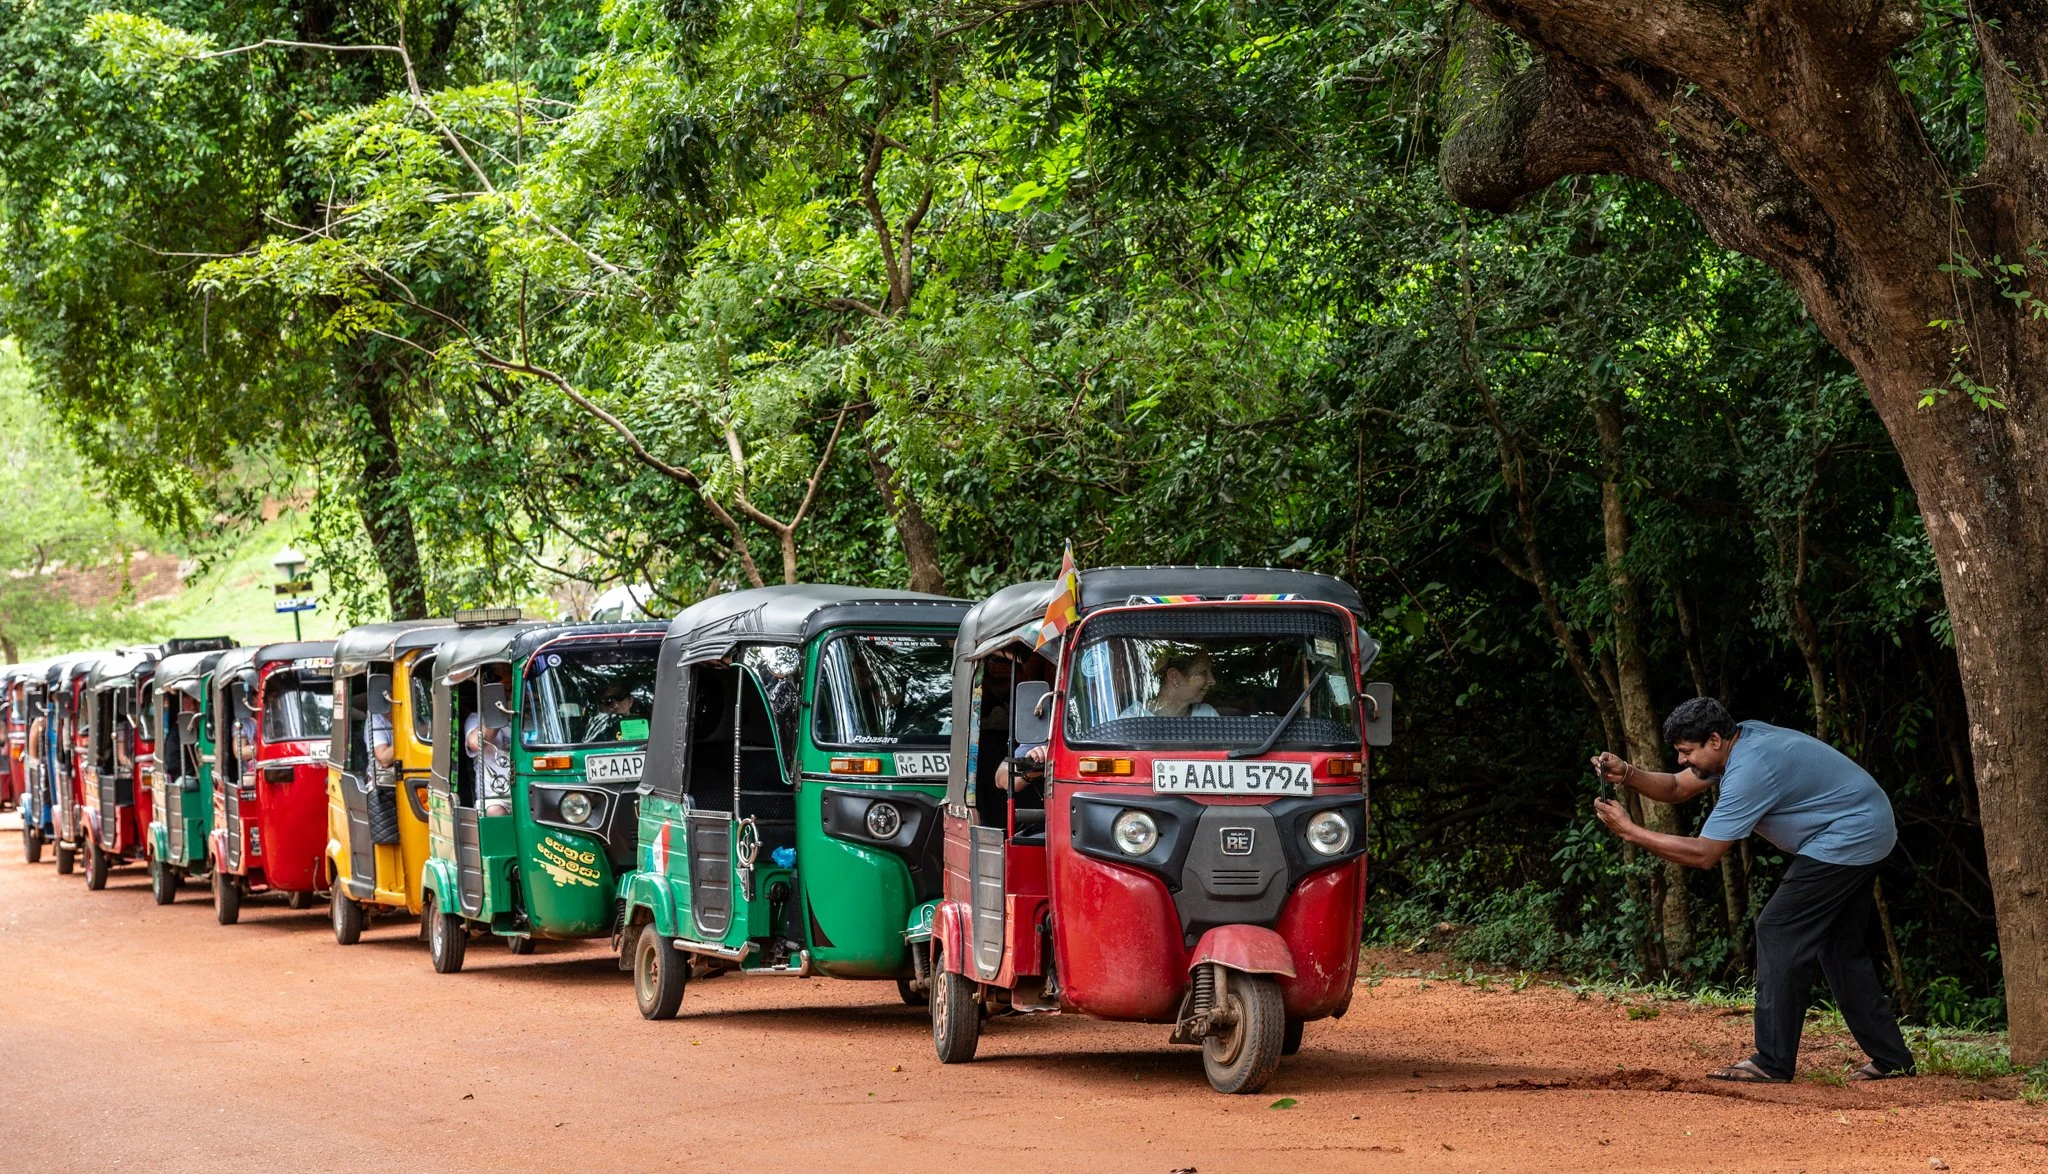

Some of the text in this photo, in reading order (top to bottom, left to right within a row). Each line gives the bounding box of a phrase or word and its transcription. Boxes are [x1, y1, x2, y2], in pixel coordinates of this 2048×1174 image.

[853, 735, 899, 744] Pabasara
[610, 757, 643, 776] AAP
[900, 755, 951, 774] NC AB
[1185, 764, 1235, 789] AAU
[1245, 765, 1309, 791] 5794
[1227, 836, 1249, 850] RE
